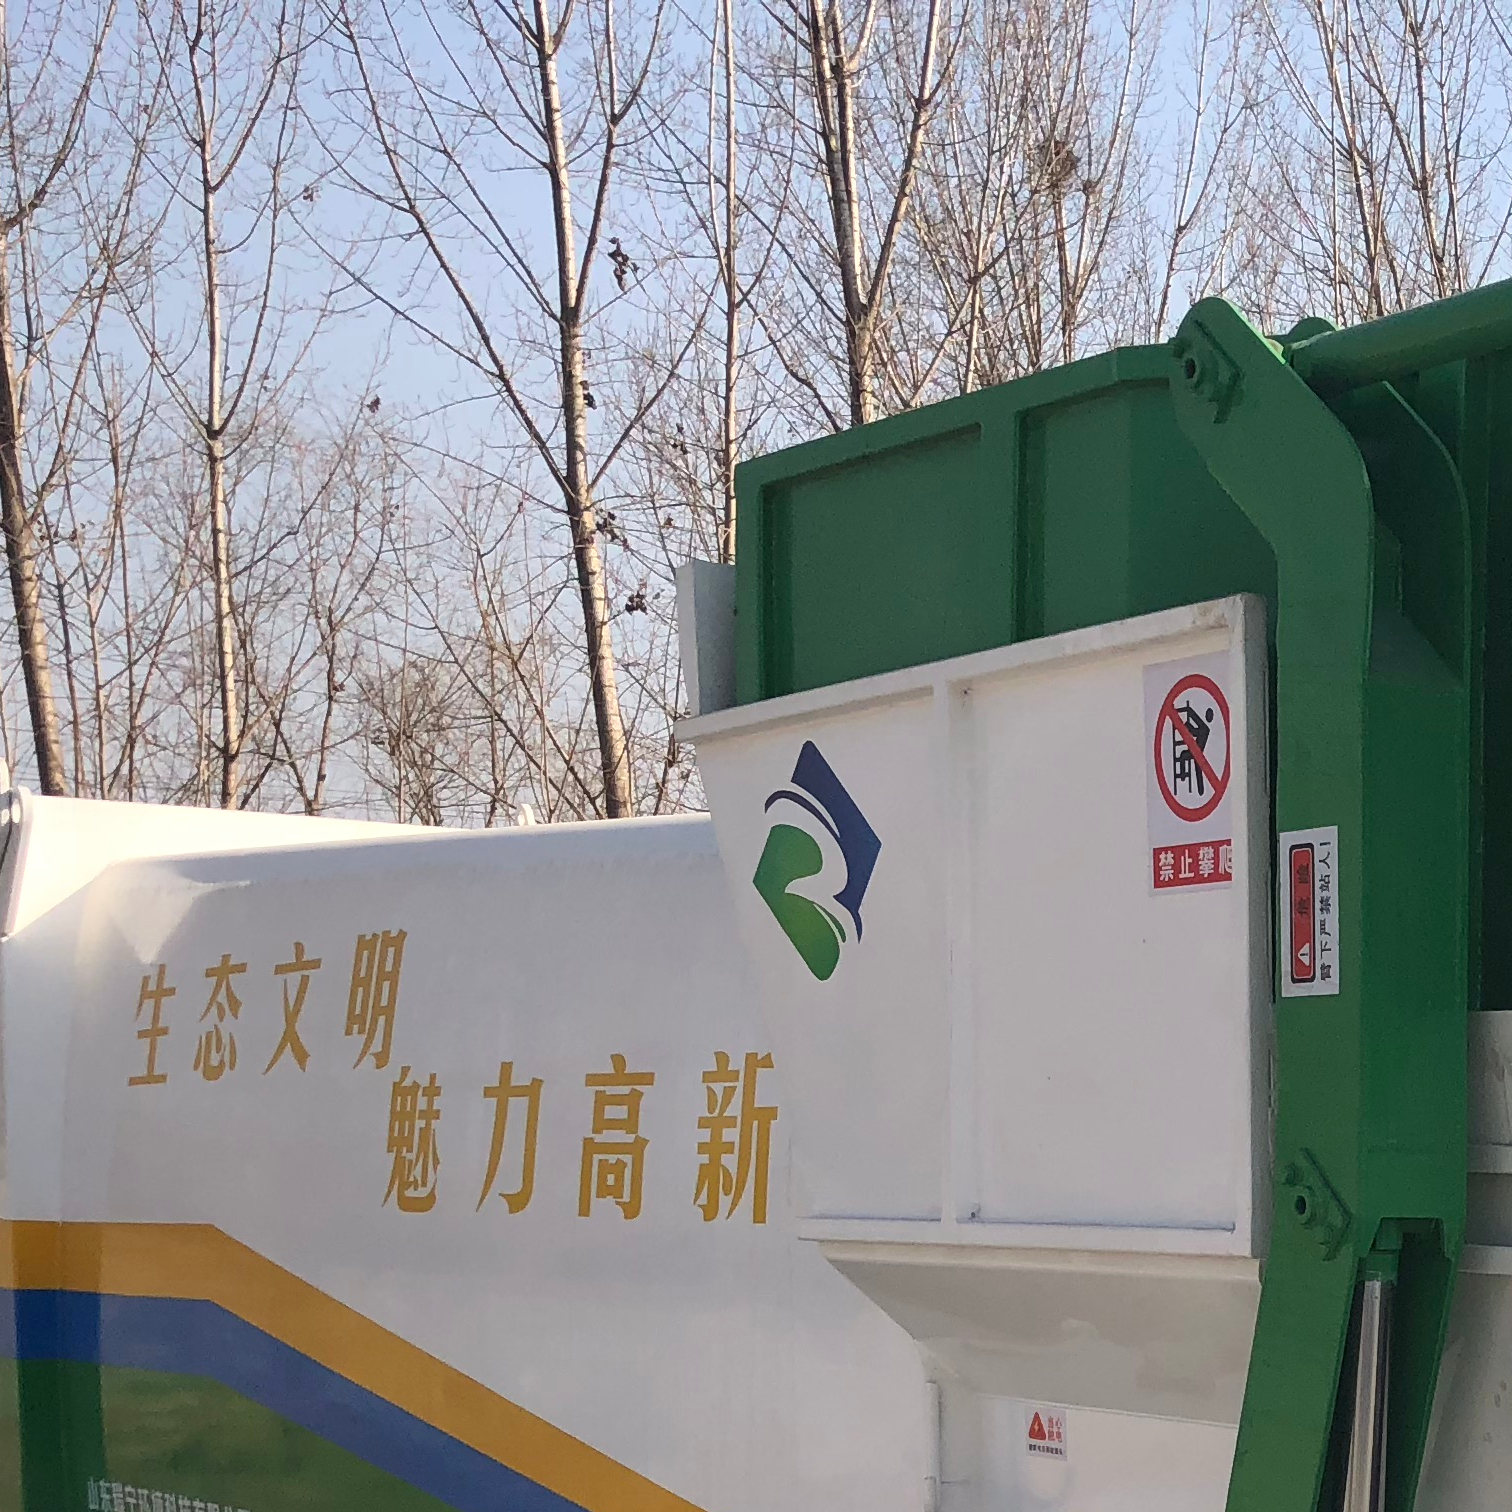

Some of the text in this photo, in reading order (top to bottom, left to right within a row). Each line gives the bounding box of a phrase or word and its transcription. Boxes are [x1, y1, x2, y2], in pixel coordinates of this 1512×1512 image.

[1158, 844, 1232, 882] 禁止攀爬
[1297, 862, 1310, 918] 危险
[127, 928, 408, 1088] 生态文明
[382, 1050, 780, 1226] 魅力高新
